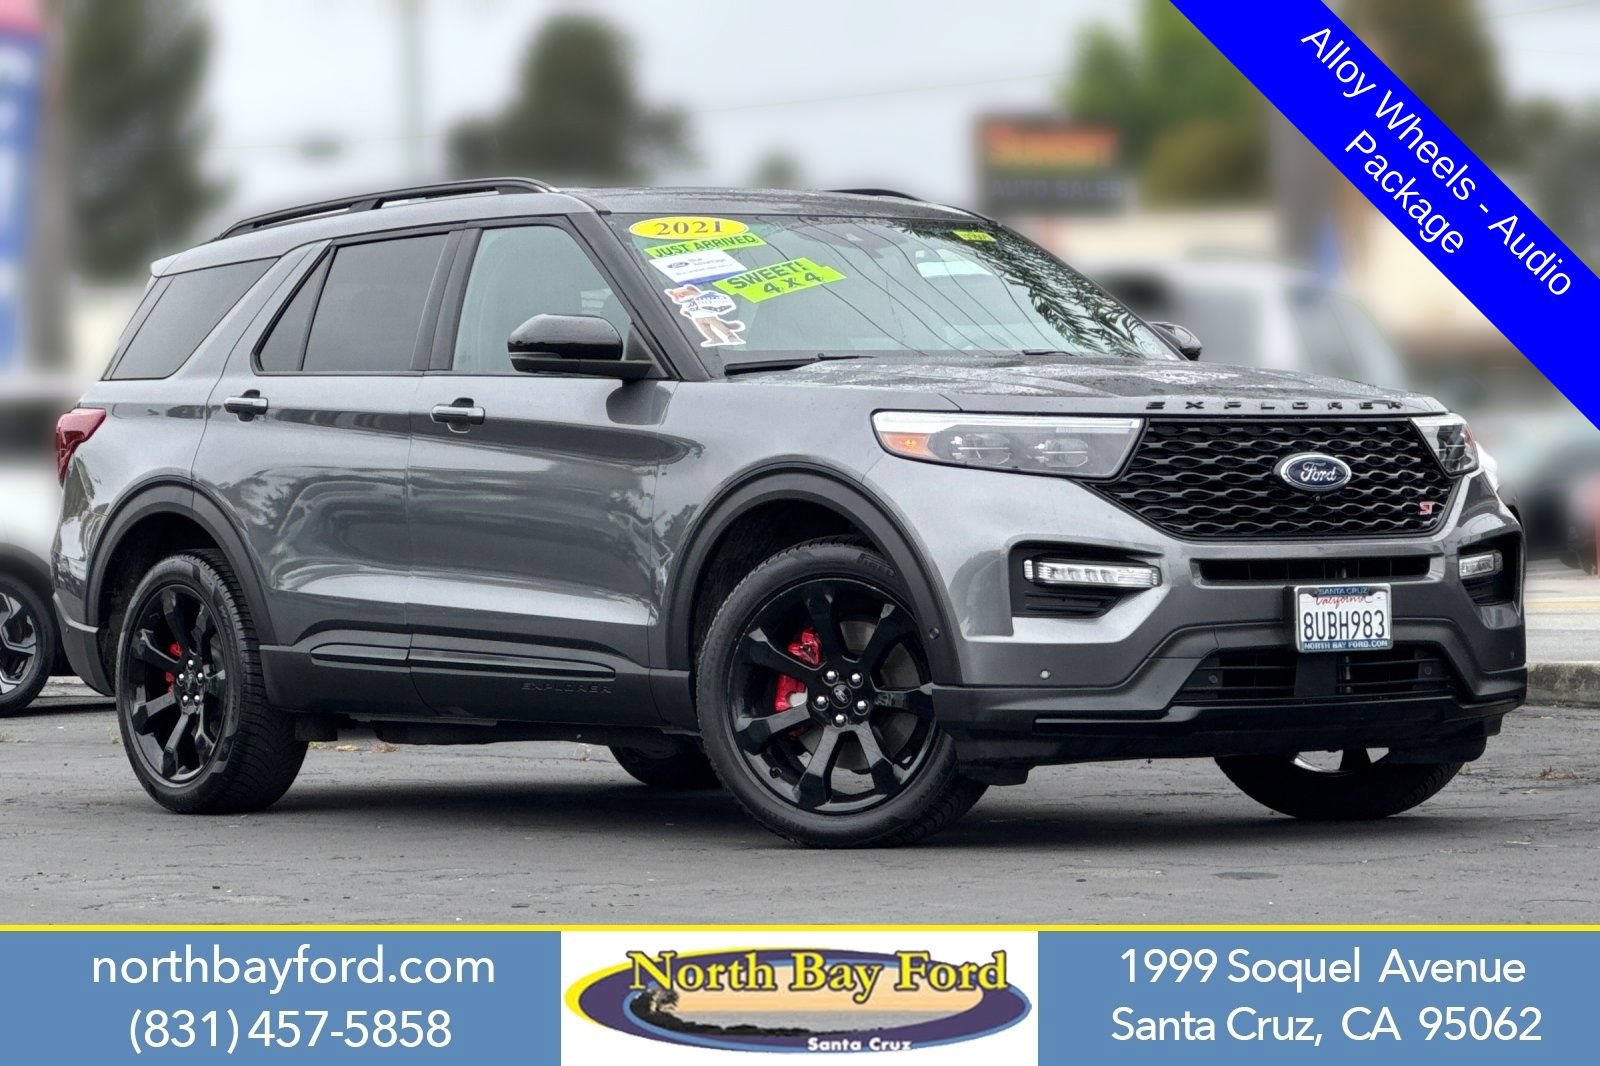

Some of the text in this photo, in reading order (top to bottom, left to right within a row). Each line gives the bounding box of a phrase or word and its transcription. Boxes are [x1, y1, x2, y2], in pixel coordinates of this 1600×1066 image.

[654, 219, 723, 236] 2021
[654, 234, 757, 258] JUST ARRIVED
[726, 260, 809, 289] SWEET!
[763, 282, 781, 294] 4
[804, 272, 822, 284] 4
[1145, 401, 1402, 411] EXPLORER
[1300, 461, 1337, 482] Ford
[1418, 501, 1434, 516] ST
[1320, 586, 1368, 595] SANTA CRUZ
[1303, 609, 1384, 641] 8UBH983
[1303, 640, 1388, 650] NORTH BAY FORD.COM
